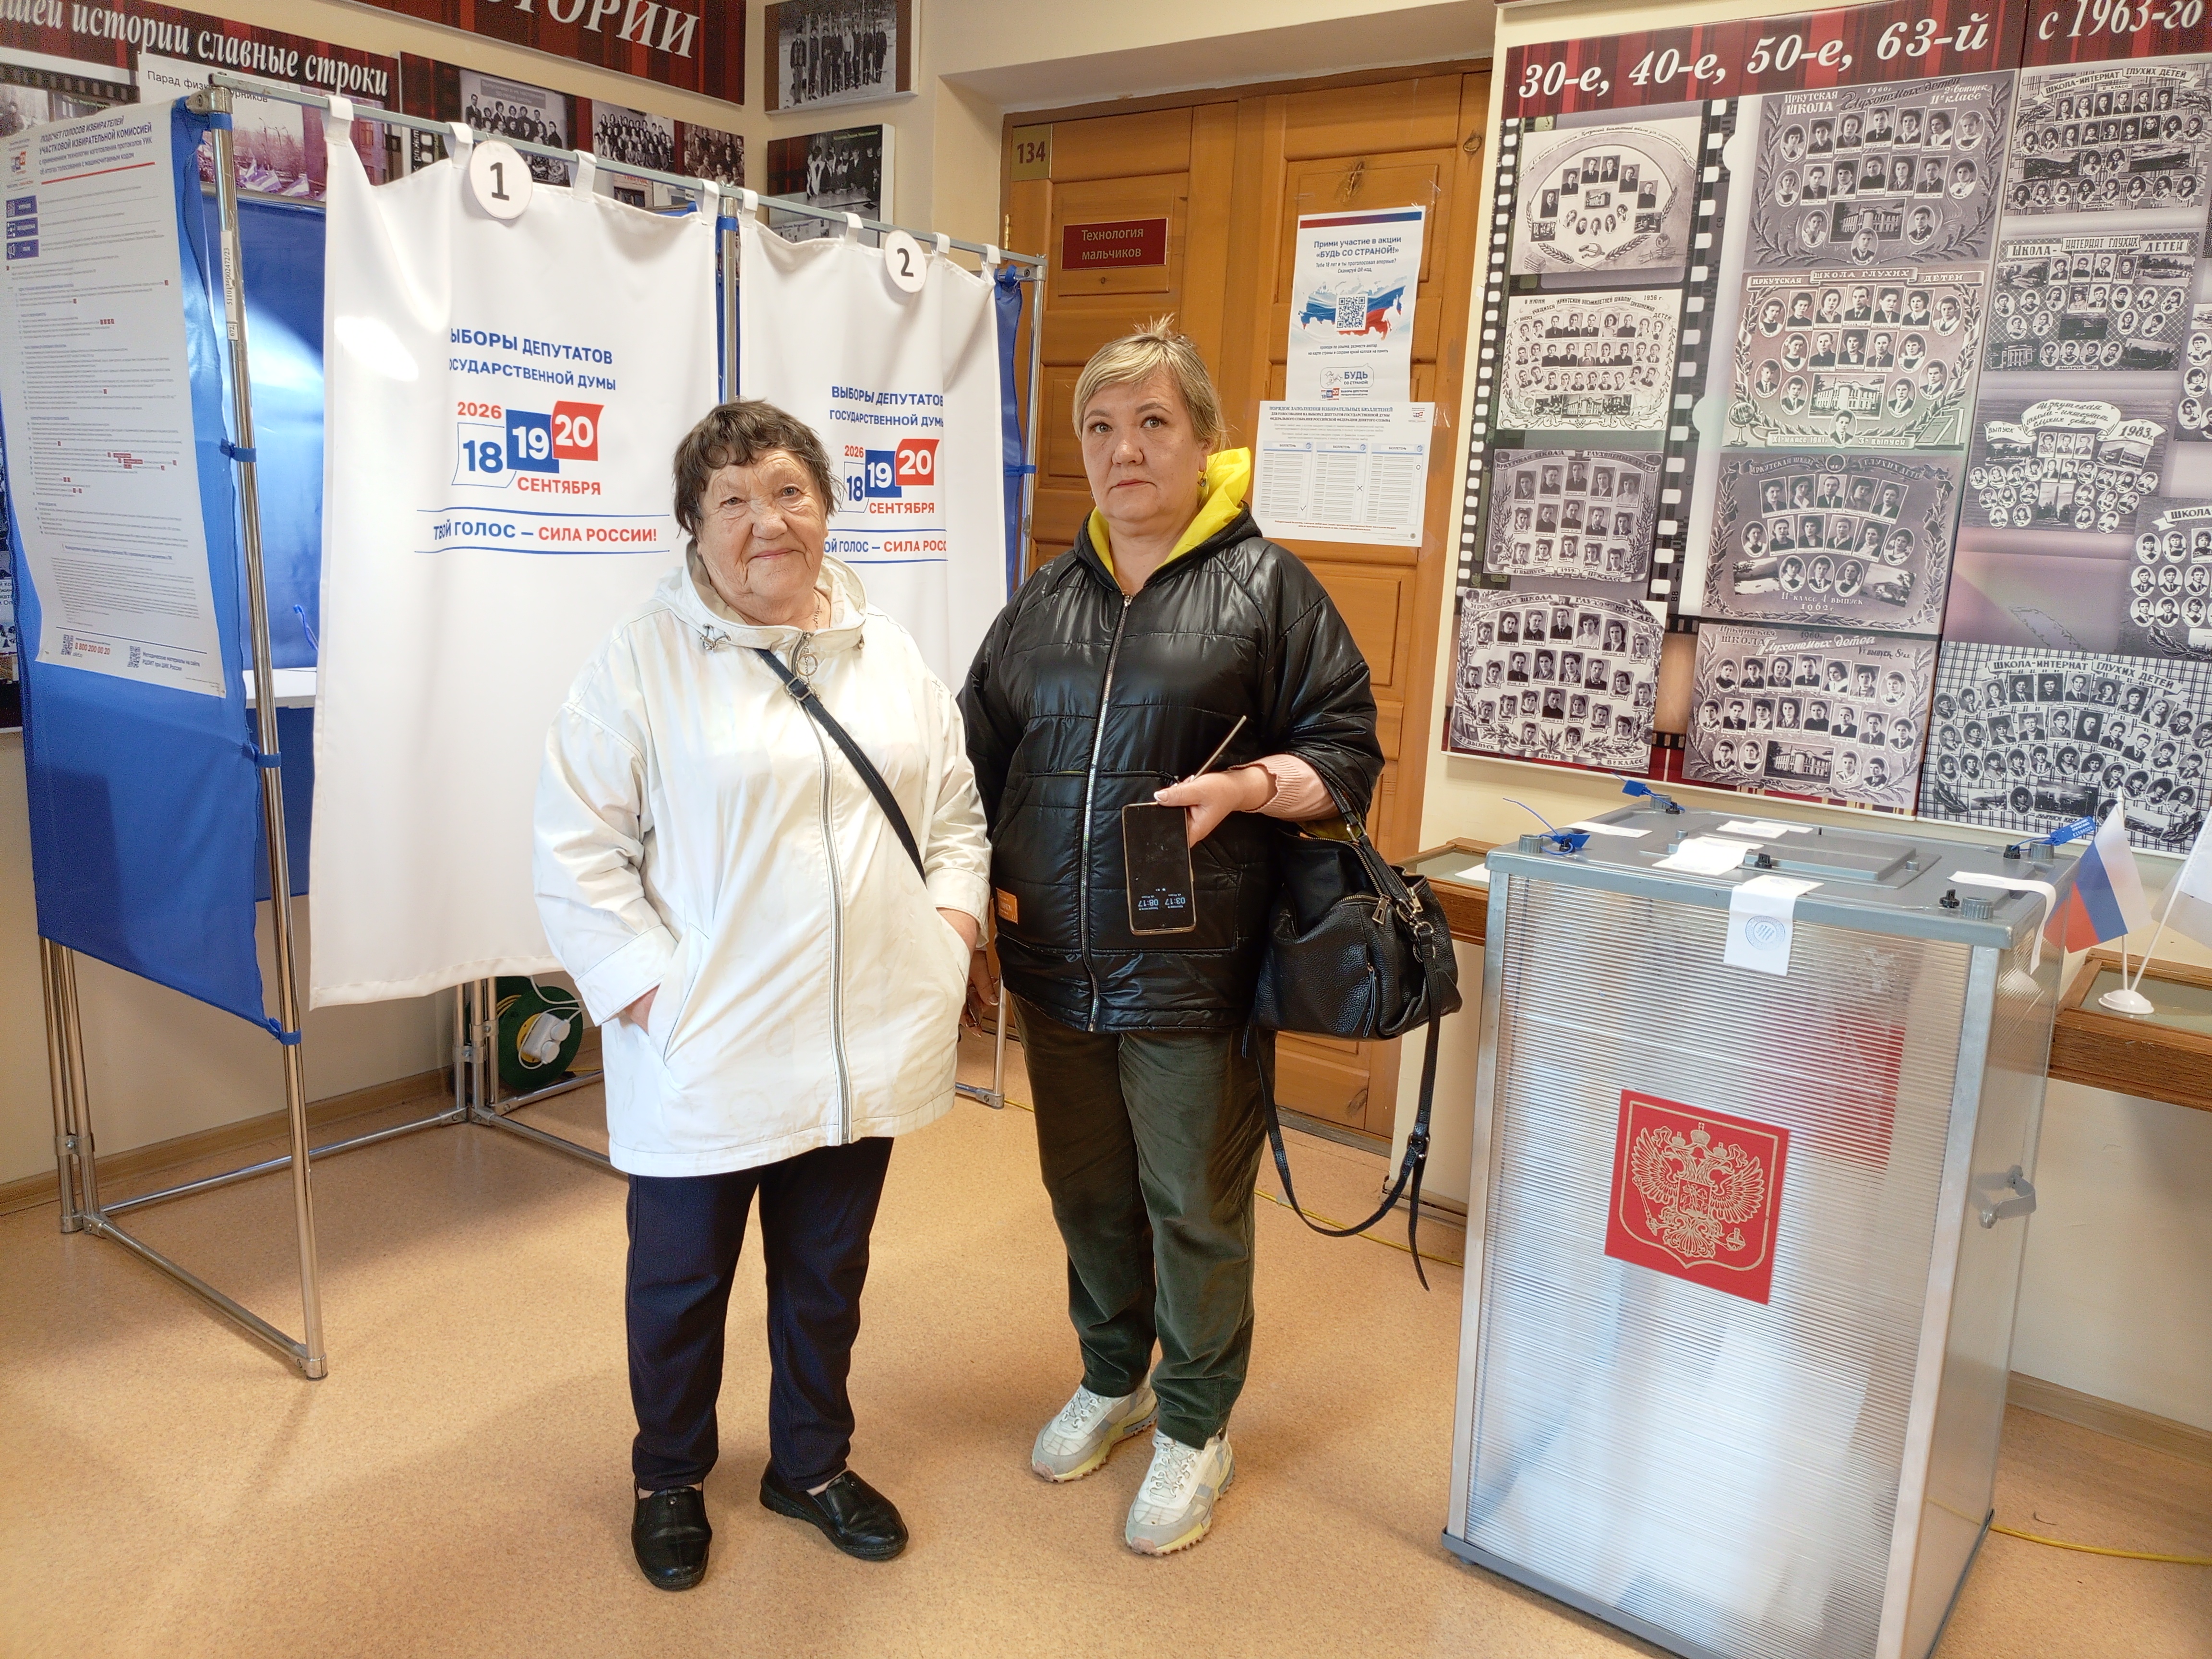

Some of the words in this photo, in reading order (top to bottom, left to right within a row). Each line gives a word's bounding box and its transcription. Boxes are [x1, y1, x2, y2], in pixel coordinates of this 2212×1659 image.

[2039, 11, 2058, 40] с
[2067, 0, 2203, 37] 1963-го
[72, 3, 189, 54] истории
[197, 30, 299, 77] славные
[305, 51, 388, 97] строки
[1519, 61, 1609, 97] 30-е,
[1628, 48, 1726, 84] 40-е,
[1747, 34, 1852, 74] 50-е,
[1877, 13, 1989, 60] 63-й
[147, 71, 180, 87] Парад
[184, 78, 268, 103] физкурников
[2045, 72, 2120, 95] ШКОЛА-ИНТЕРНАТ
[2159, 69, 2187, 78] ДЕТЕЙ
[1785, 91, 1838, 104] ИРКУТСКАЯ
[1786, 102, 1834, 115] ШКОЛА
[116, 122, 152, 138] КОМИССИЕЙ
[1017, 141, 1046, 164] 134
[490, 162, 510, 201] 1
[1082, 228, 1144, 241] Технология
[1314, 241, 1338, 249] Прими
[1340, 239, 1370, 248] участие
[2066, 238, 2104, 249] ИНТЕРНАТ
[2144, 240, 2184, 252] ДЕТЕЙ
[1082, 248, 1142, 260] мальчиков
[1316, 250, 1340, 258] «БУДЬ
[1355, 245, 1399, 255] СТРАНОЙ!»
[897, 248, 914, 277] 2
[1814, 271, 1855, 279] ШКОЛА
[1861, 269, 1909, 277] ГЛУХИХ
[1923, 273, 1963, 282] ДЕТЕЙ
[1653, 313, 1672, 321] ДЕТЕЙ
[451, 328, 518, 351] ЫБОРЫ
[522, 338, 613, 364] ДЕПУТАТОВ
[449, 358, 575, 386] СУДАРСТВЕННОЙ
[577, 374, 616, 391] ДУМЫ
[1344, 371, 1368, 380] БУДЬ
[832, 386, 874, 403] ВЫБОРЫ
[457, 402, 502, 419] 2026
[830, 410, 918, 425] ГОСУДАРСТВЕННОЙ
[463, 440, 504, 474] 18
[512, 426, 550, 460] 19
[555, 414, 595, 448] 20
[1871, 438, 1906, 446] ВЫПУСК
[844, 445, 864, 458] 2026
[1864, 459, 1899, 471] ГЛУХИХ
[847, 475, 863, 502] 18
[868, 462, 892, 488] 19
[899, 450, 932, 474] 20
[517, 477, 601, 495] СЕНТЯБРЯ
[869, 502, 934, 514] СЕНТЯБРЯ
[2171, 509, 2212, 519] ШКОЛА
[433, 519, 451, 541] ТВОЙ
[455, 521, 516, 538] ГОЛОС
[538, 527, 583, 542] СИЛА
[587, 529, 657, 542] РОССИИ!
[839, 541, 869, 552] ГОЛОС
[884, 541, 920, 552] СИЛА
[1721, 636, 1766, 647] ШКОЛА
[1994, 659, 2089, 671] ШКОЛА-ИНТЕРНАТ
[2096, 663, 2135, 678] ГЛУХИХ
[2139, 673, 2175, 689] ДЕТЕЙ
